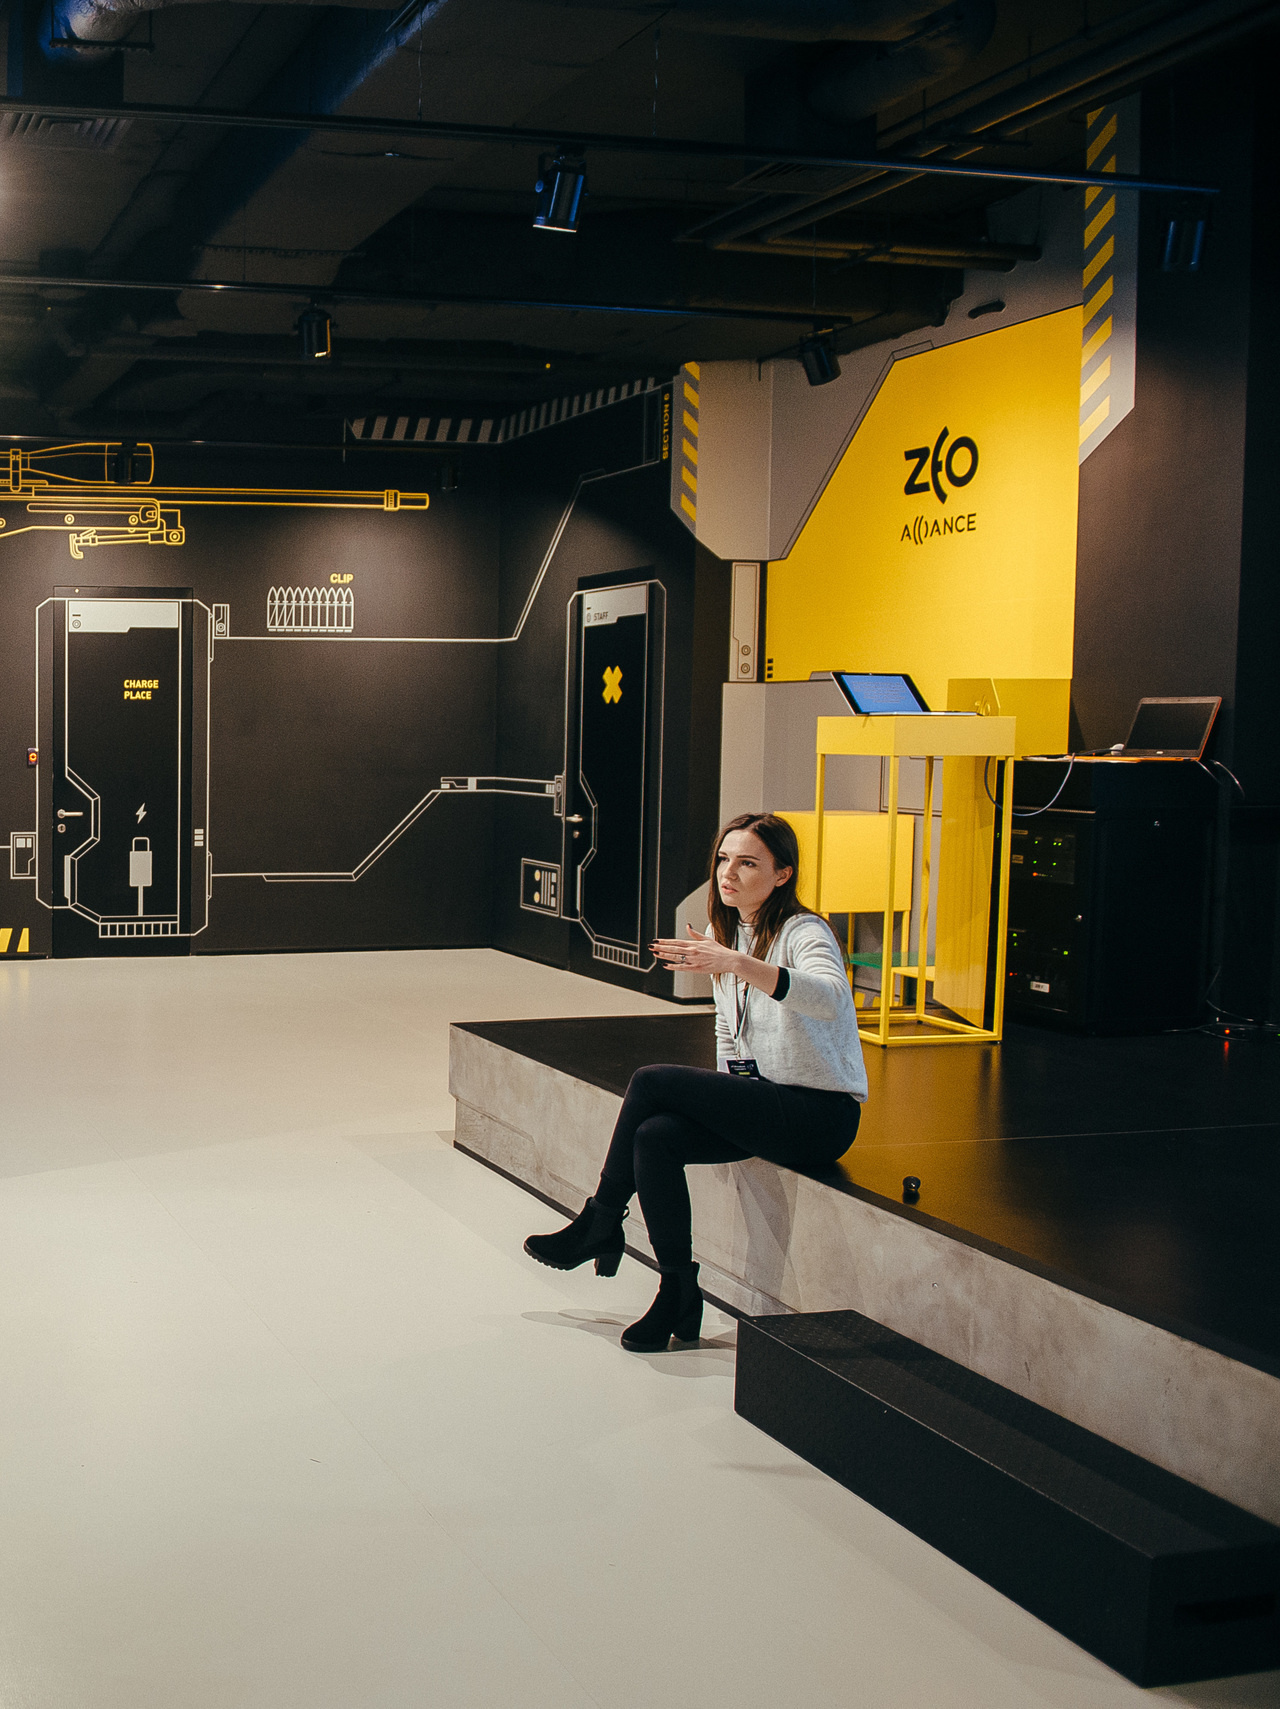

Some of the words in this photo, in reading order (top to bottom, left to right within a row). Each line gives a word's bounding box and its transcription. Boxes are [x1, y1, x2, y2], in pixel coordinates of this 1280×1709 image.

[662, 403, 670, 460] SECTION
[330, 573, 354, 584] CLIP
[593, 611, 609, 621] STAFF
[123, 679, 159, 689] CHARGE
[123, 690, 152, 700] PLACE
